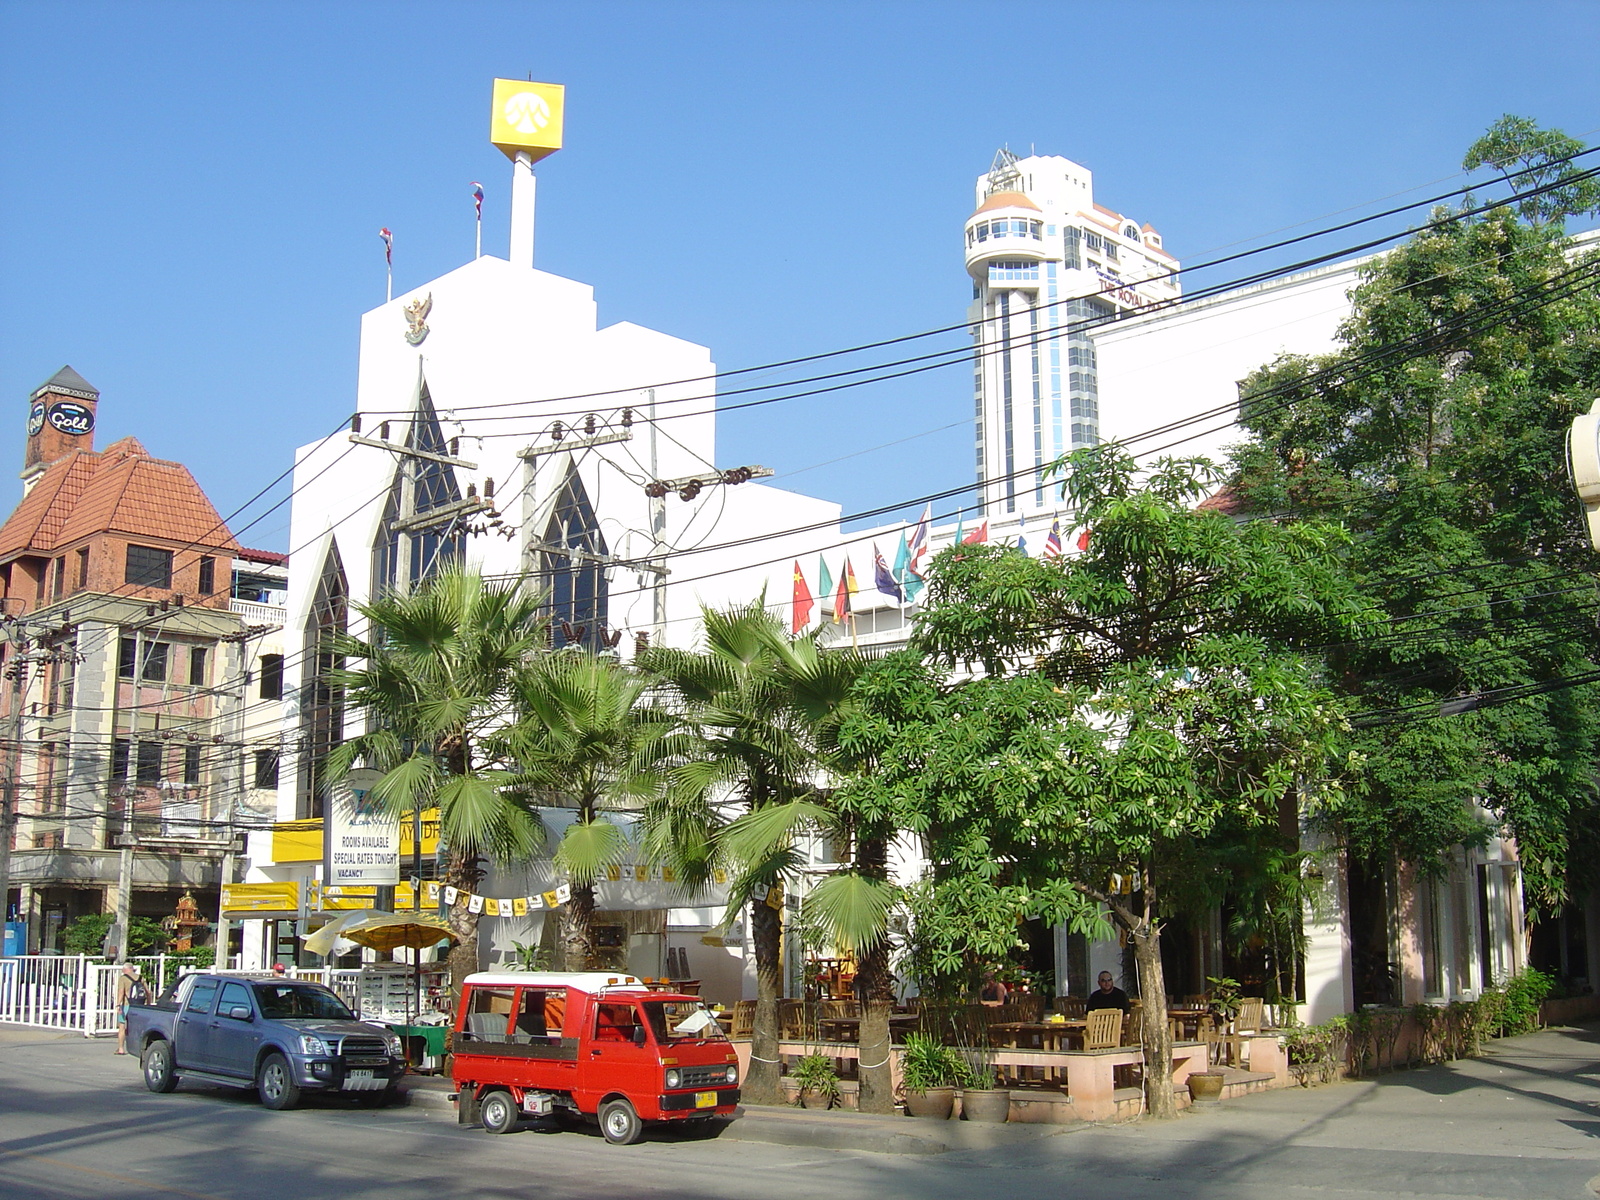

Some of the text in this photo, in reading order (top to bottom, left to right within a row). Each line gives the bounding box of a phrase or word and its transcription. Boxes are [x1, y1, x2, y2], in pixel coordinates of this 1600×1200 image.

[1118, 288, 1143, 308] ROYAL
[51, 412, 89, 430] Gold
[342, 836, 389, 848] ROOMS AVAILABLE
[333, 852, 397, 865] SPECIAL RATES TONIGHT
[337, 869, 363, 878] VACANCY
